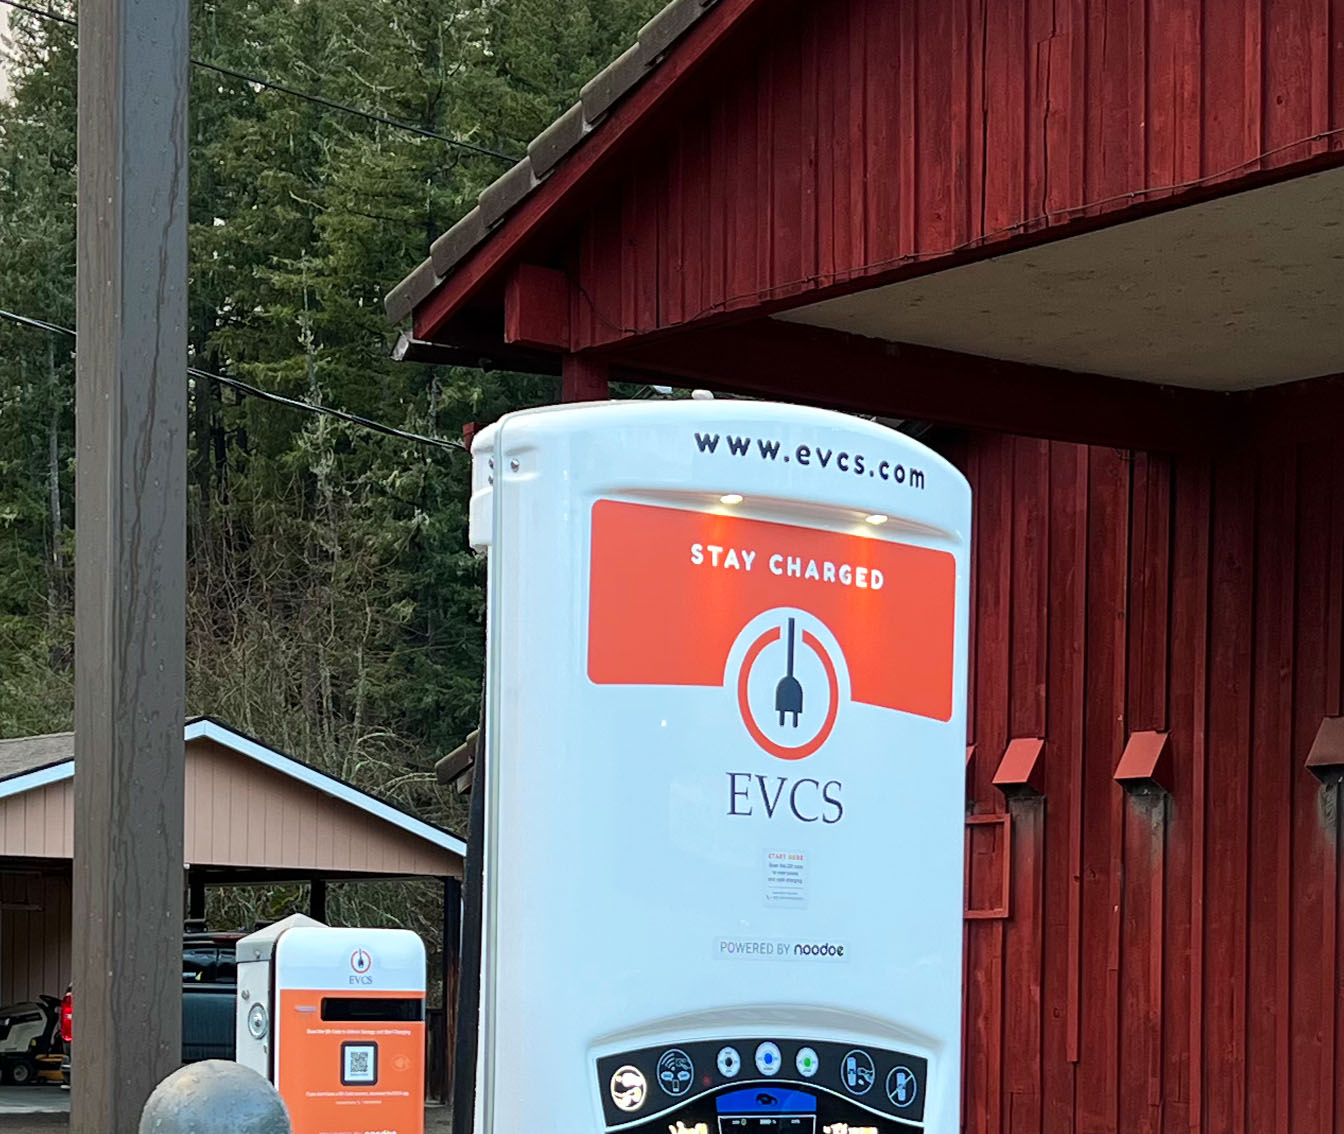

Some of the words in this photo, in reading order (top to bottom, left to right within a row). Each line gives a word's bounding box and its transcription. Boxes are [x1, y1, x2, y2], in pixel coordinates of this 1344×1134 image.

[694, 432, 926, 490] www.evcs.com
[690, 543, 756, 571] STAY
[769, 554, 884, 590] CHARGED
[726, 770, 845, 824] EVCS
[720, 941, 774, 955] POWERED
[777, 943, 790, 955] BY
[794, 942, 844, 957] noodoe
[349, 975, 373, 985] EVCS
